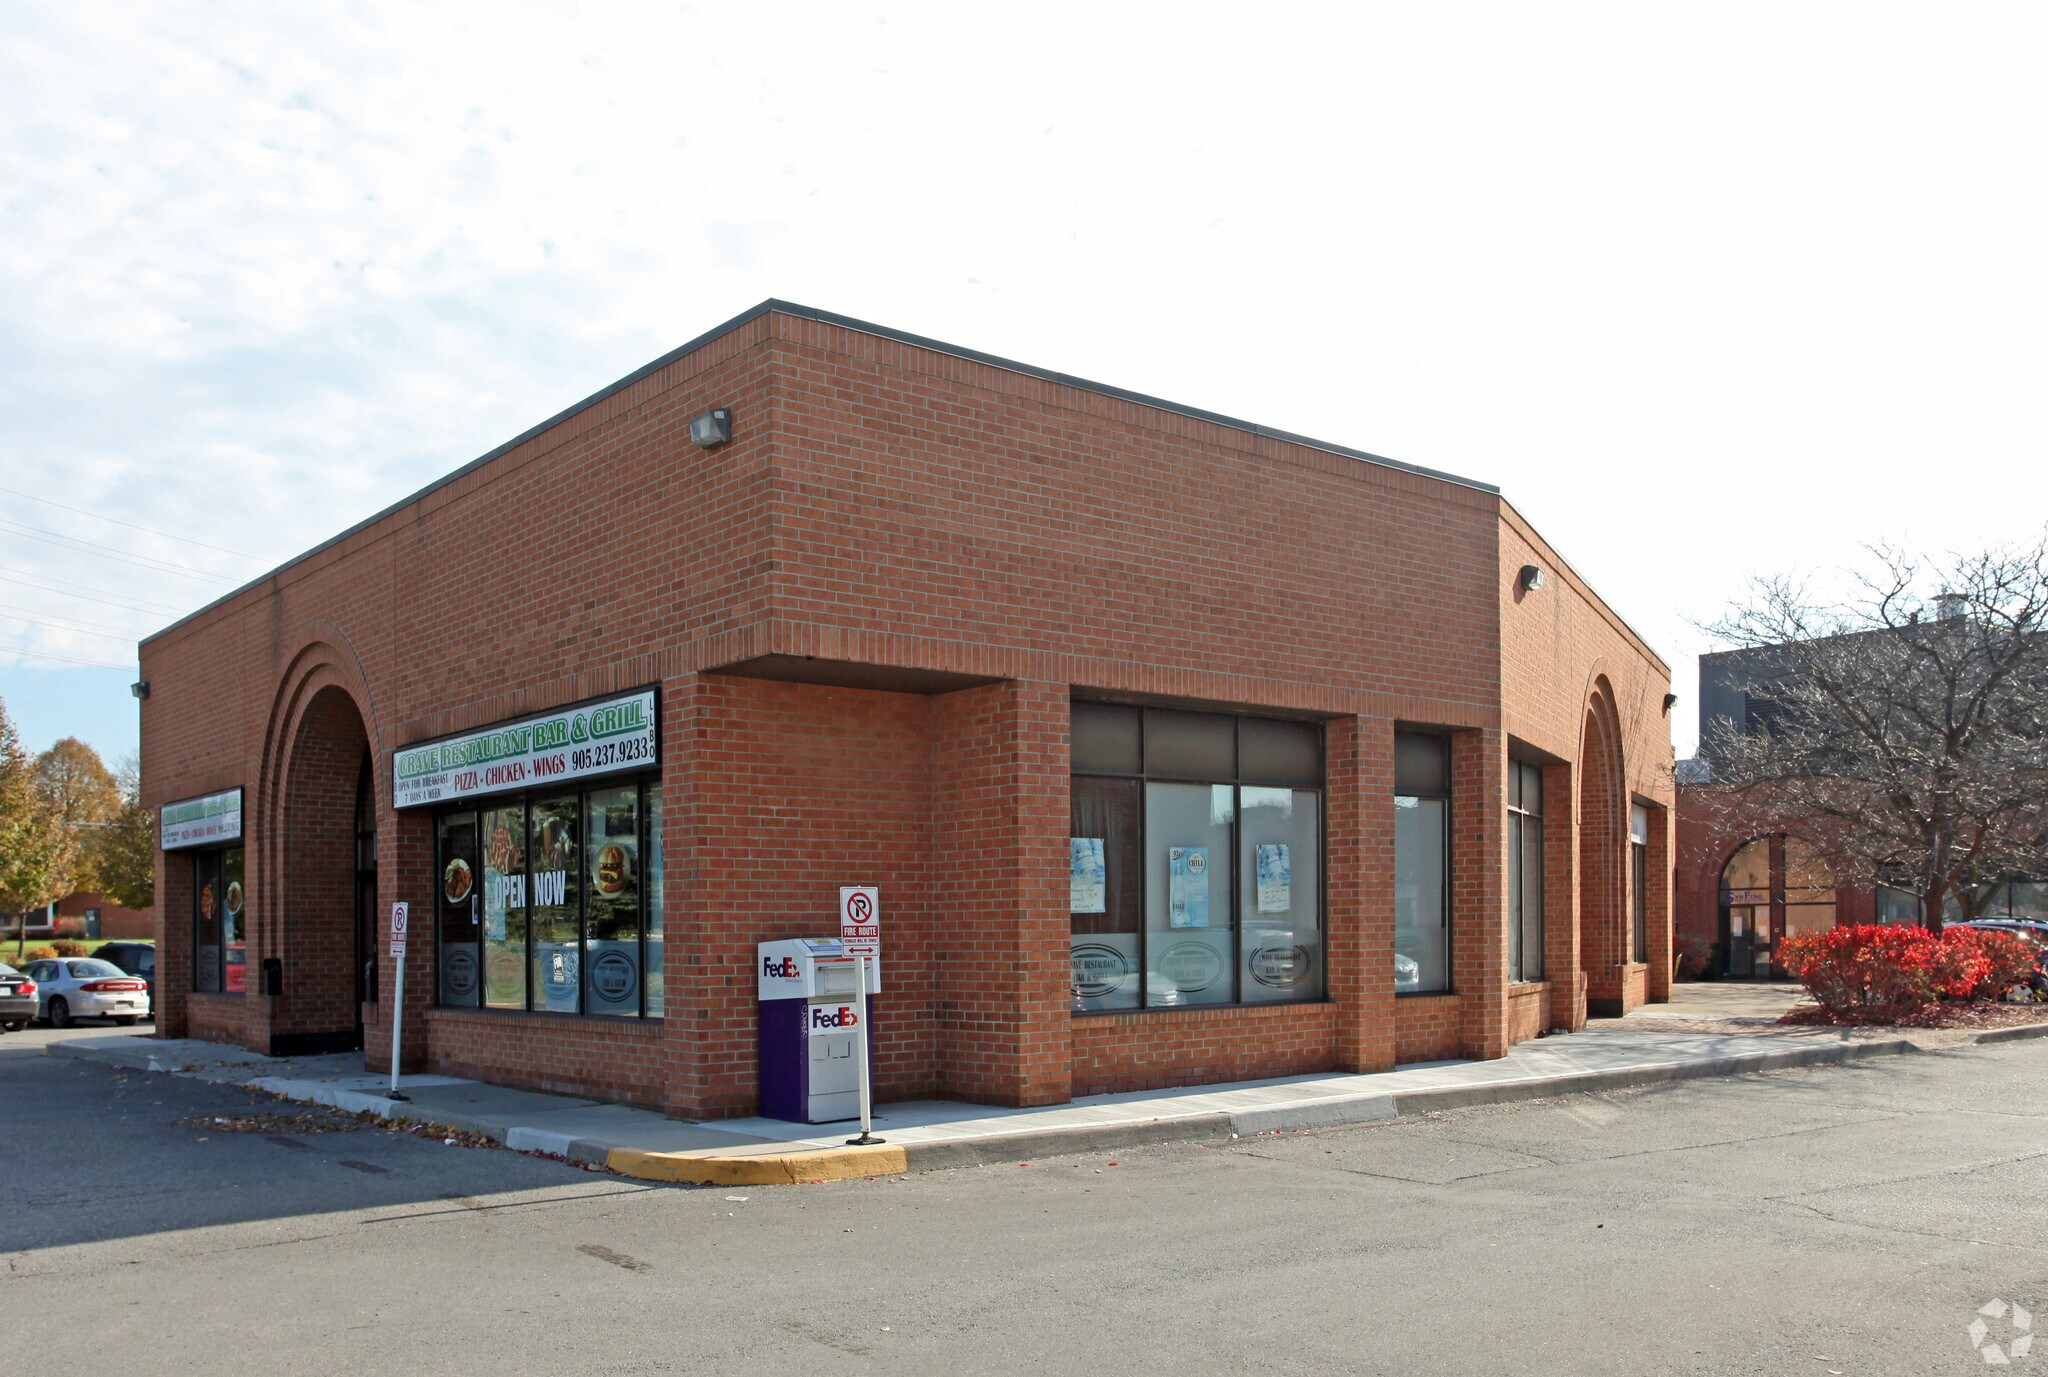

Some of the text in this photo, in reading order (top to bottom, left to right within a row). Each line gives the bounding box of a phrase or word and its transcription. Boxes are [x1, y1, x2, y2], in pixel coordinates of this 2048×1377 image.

[398, 699, 648, 779] CRAVE RESTAURANT BAR & GRILL
[572, 737, 648, 771] 905.237.9233
[398, 773, 448, 792] OPEN FOR BREAKFAST
[454, 771, 478, 792] PIZZA
[486, 762, 525, 786] CHICKEN
[533, 753, 565, 777] WINGS
[410, 792, 421, 802] DAYS
[428, 788, 441, 799] WEEK
[495, 870, 566, 908] OPEN NOW
[844, 927, 877, 936] FIRE ROUTE
[764, 957, 800, 978] FedEx
[1084, 960, 1116, 969] RESTAURANT
[813, 1007, 858, 1028] FedEx
